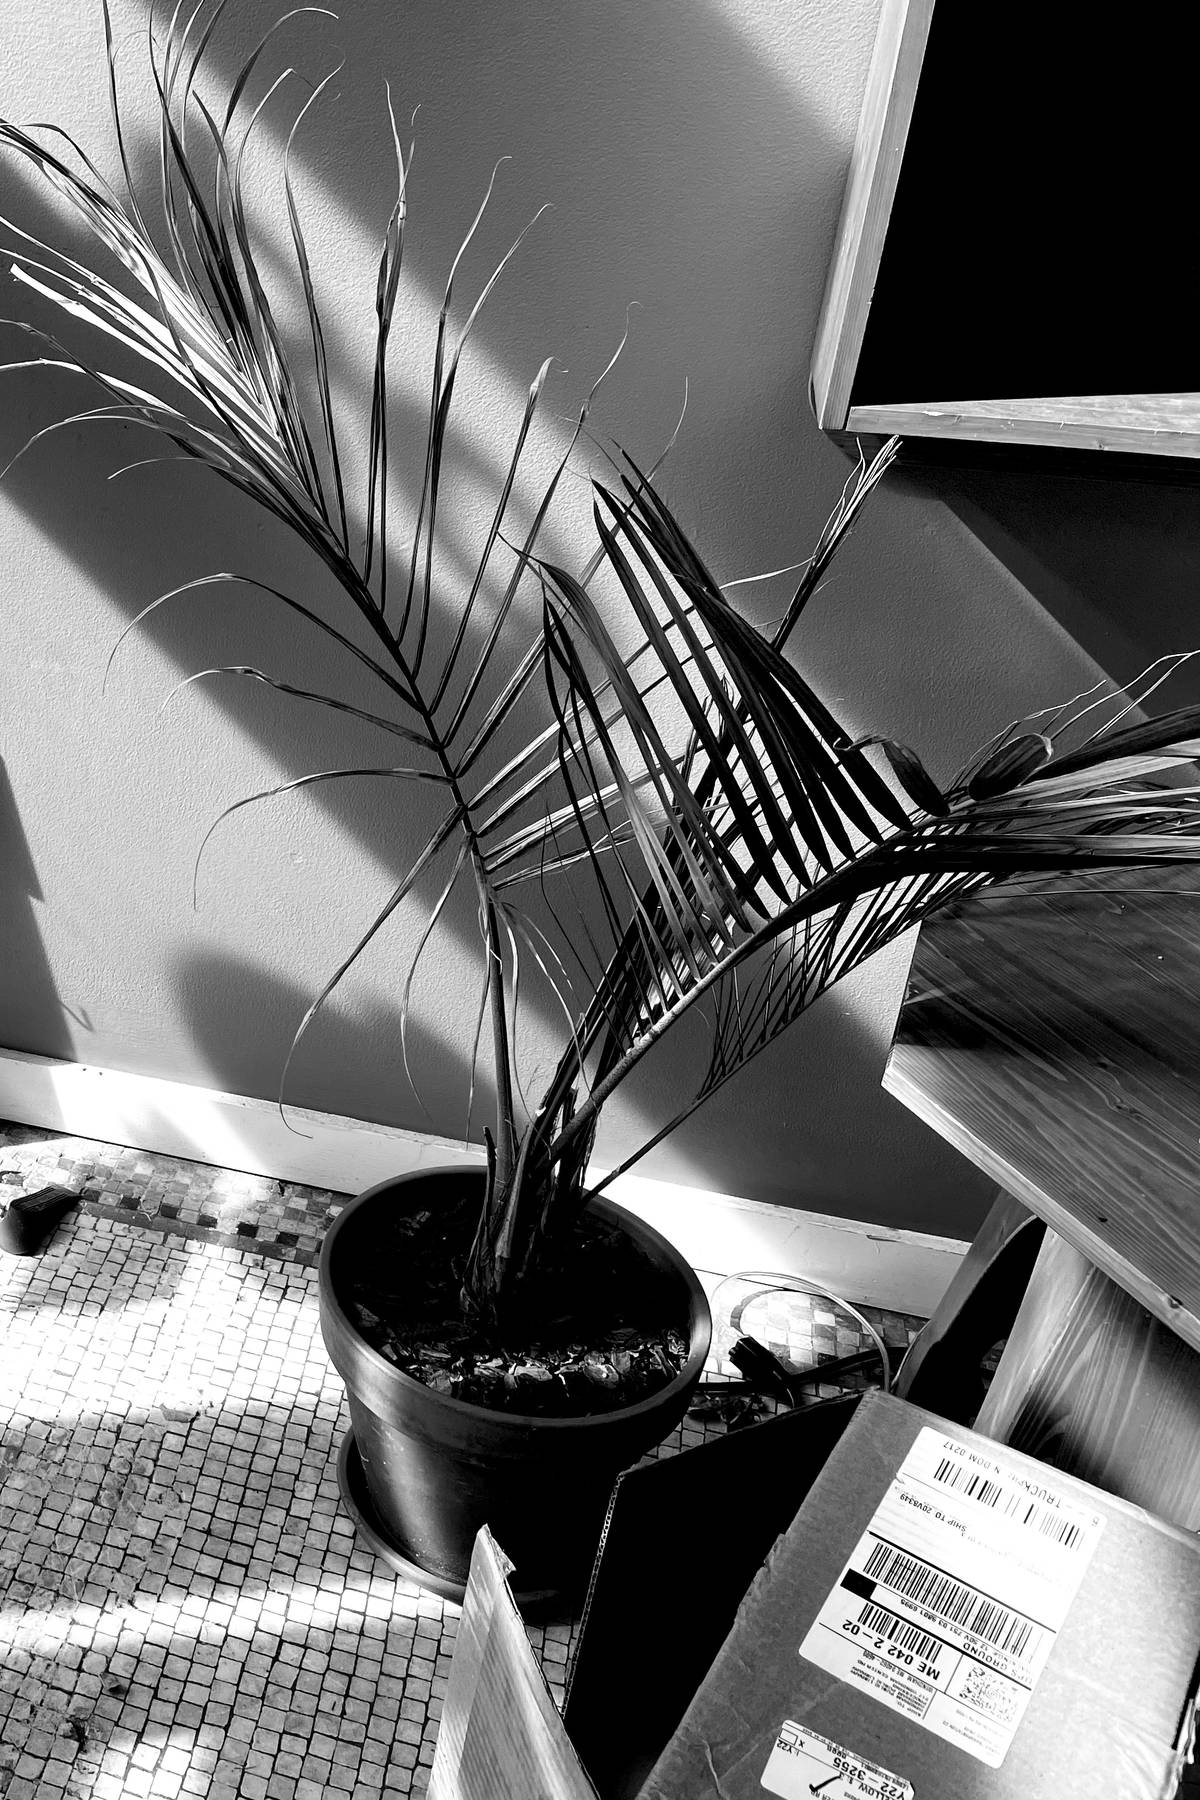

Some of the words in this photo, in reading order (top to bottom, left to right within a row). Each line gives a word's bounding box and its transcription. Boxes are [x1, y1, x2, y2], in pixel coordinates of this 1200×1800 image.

[942, 1439, 966, 1456] 0217
[946, 1516, 967, 1532] SHIP
[886, 1643, 913, 1665] 042
[961, 1640, 1007, 1671] GROUND
[916, 1660, 940, 1680] ME
[775, 1739, 794, 1753] Y22
